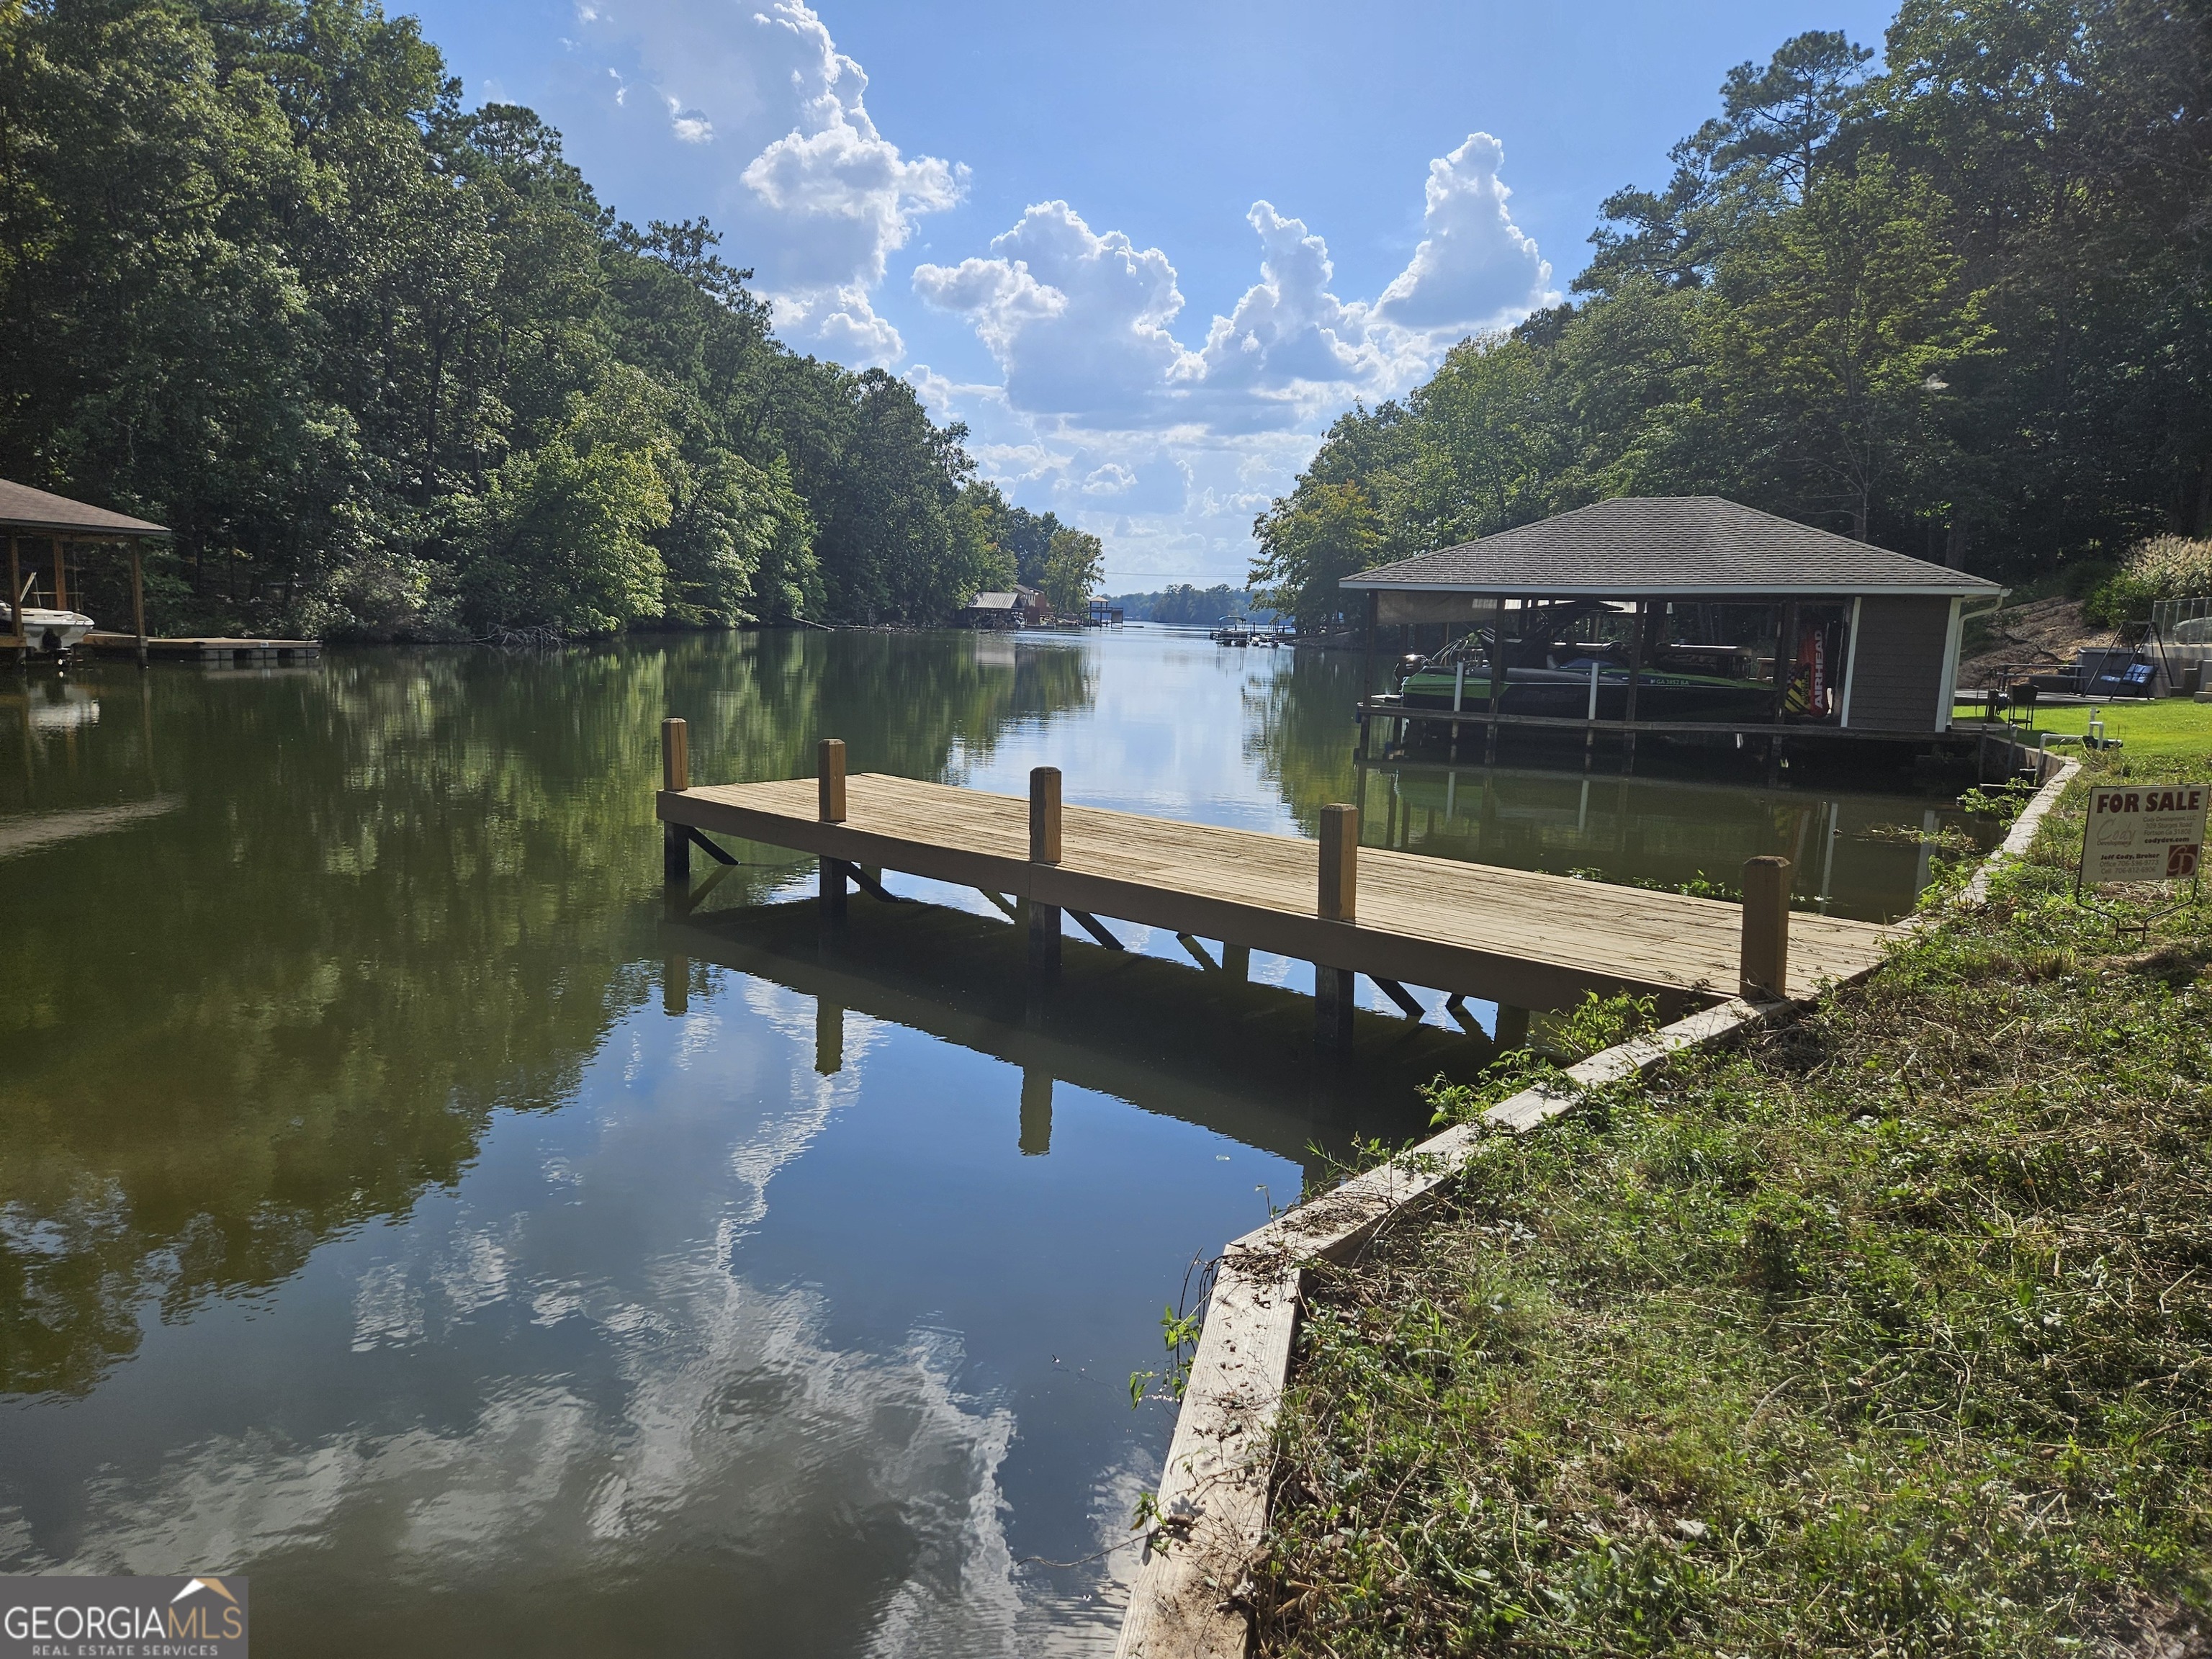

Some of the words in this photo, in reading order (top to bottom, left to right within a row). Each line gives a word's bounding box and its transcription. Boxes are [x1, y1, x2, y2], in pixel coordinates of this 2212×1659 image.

[1815, 630, 1824, 709] AIRHEAD
[2096, 793, 2139, 814] FOR
[2144, 791, 2201, 812] SALE
[2096, 817, 2136, 848] Cody
